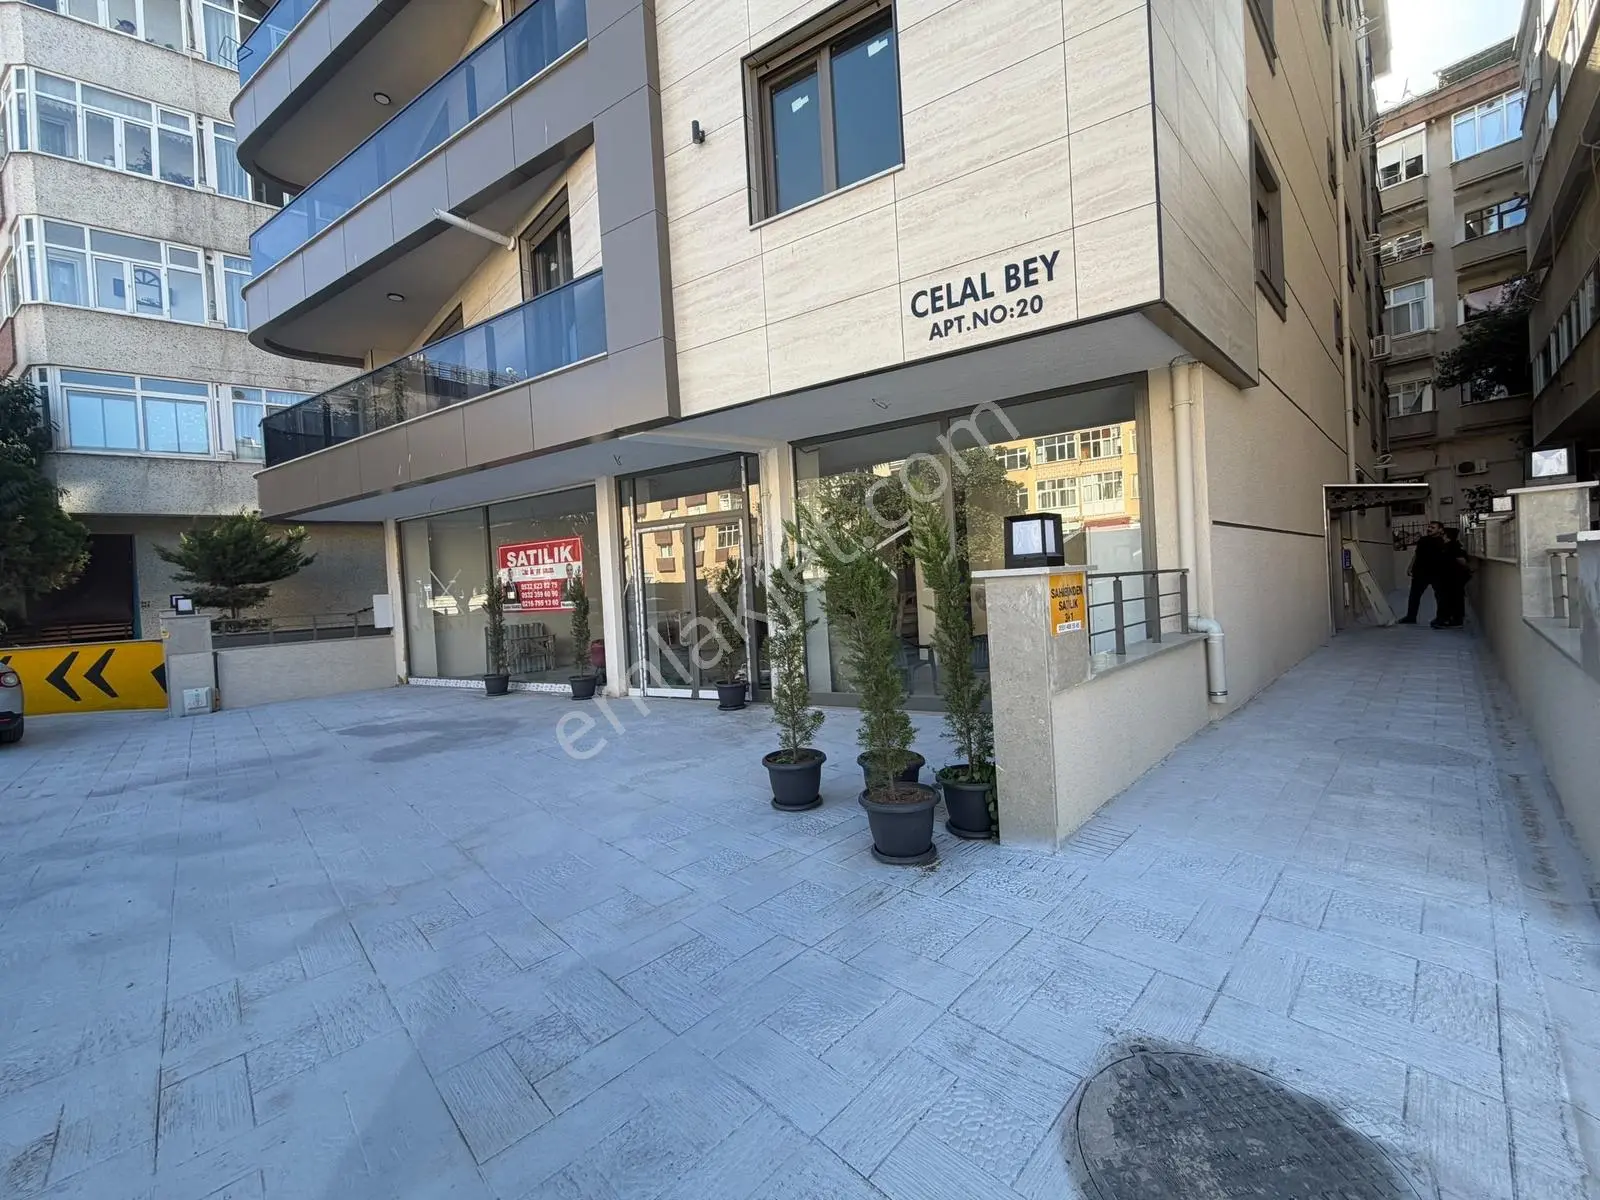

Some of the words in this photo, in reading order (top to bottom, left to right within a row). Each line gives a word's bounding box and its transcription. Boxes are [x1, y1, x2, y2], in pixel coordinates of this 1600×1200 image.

[911, 272, 995, 318] CELAL
[1004, 250, 1060, 293] BEY
[929, 294, 1043, 341] APT.NO:20
[506, 545, 573, 567] SATILIK
